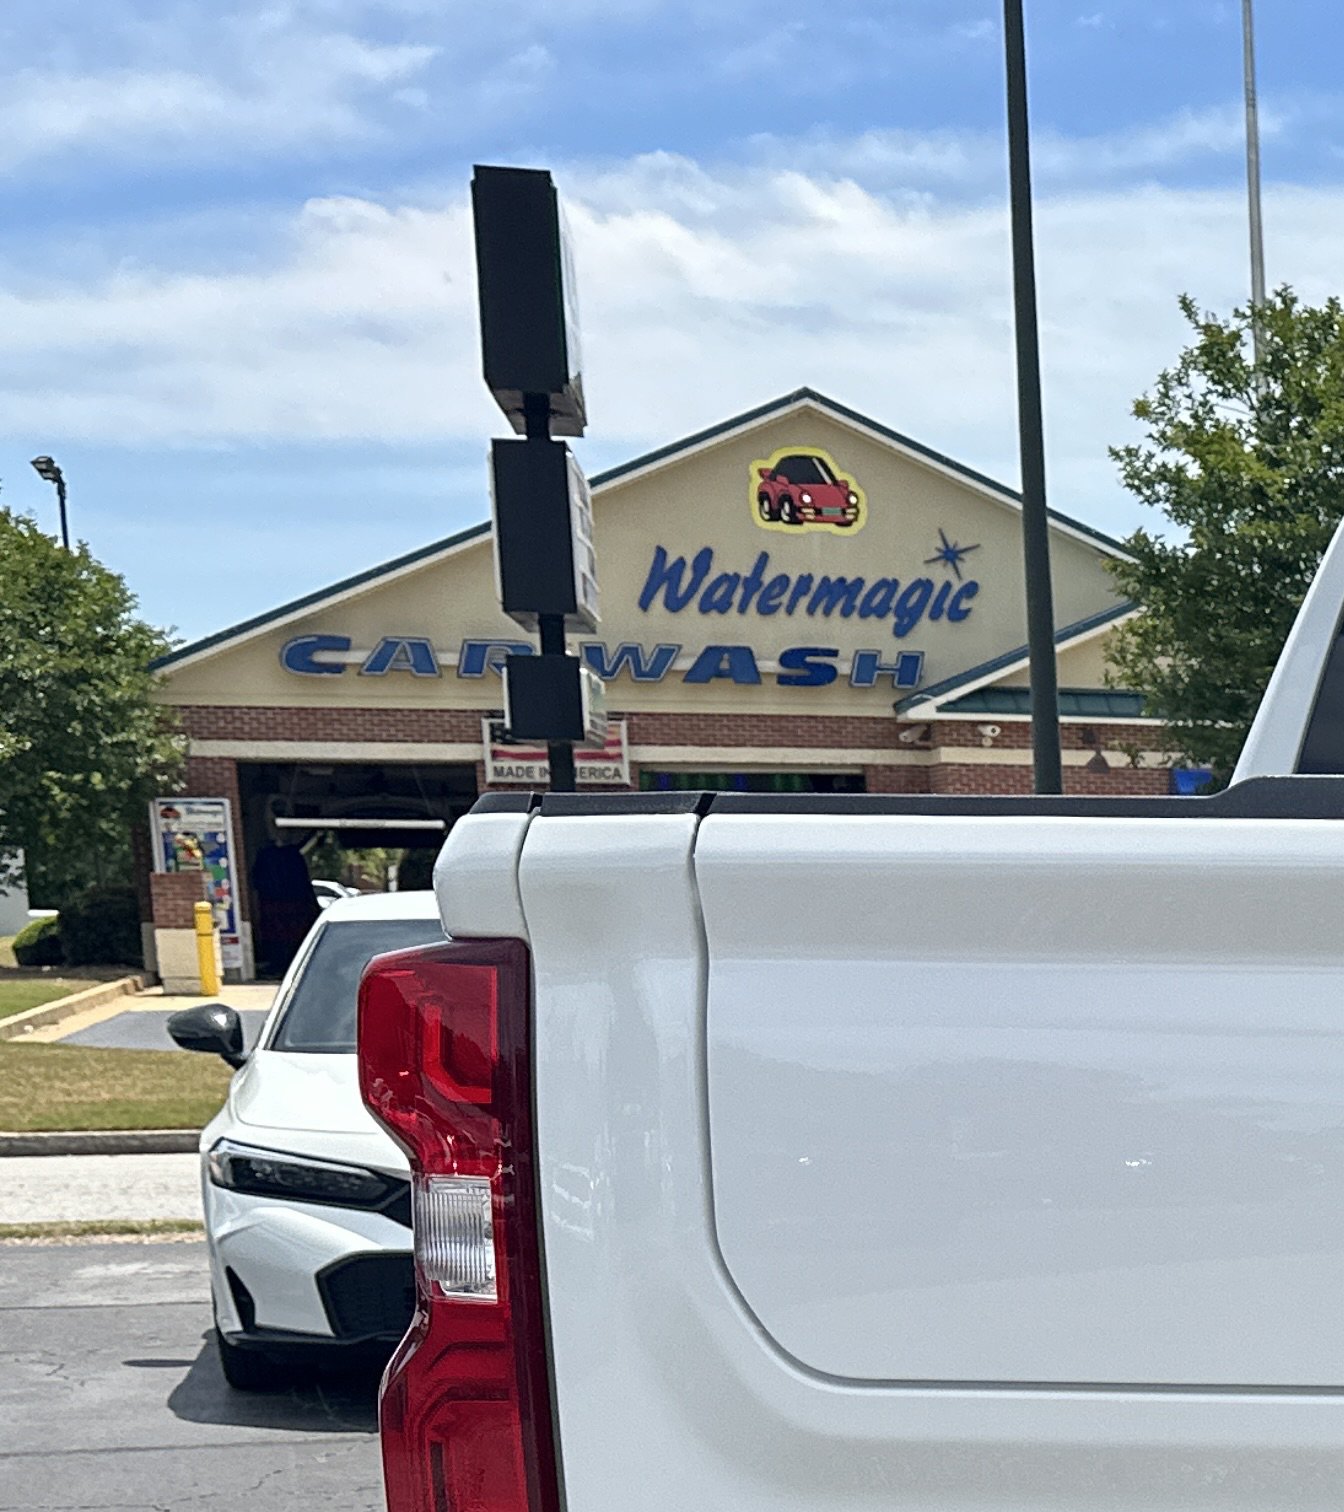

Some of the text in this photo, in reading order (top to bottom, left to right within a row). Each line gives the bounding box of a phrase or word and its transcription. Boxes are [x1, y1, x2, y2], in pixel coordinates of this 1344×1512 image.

[641, 545, 979, 638] Watermagic
[579, 640, 924, 689] WASH
[493, 766, 534, 779] MADE
[575, 766, 622, 779] ERICA
